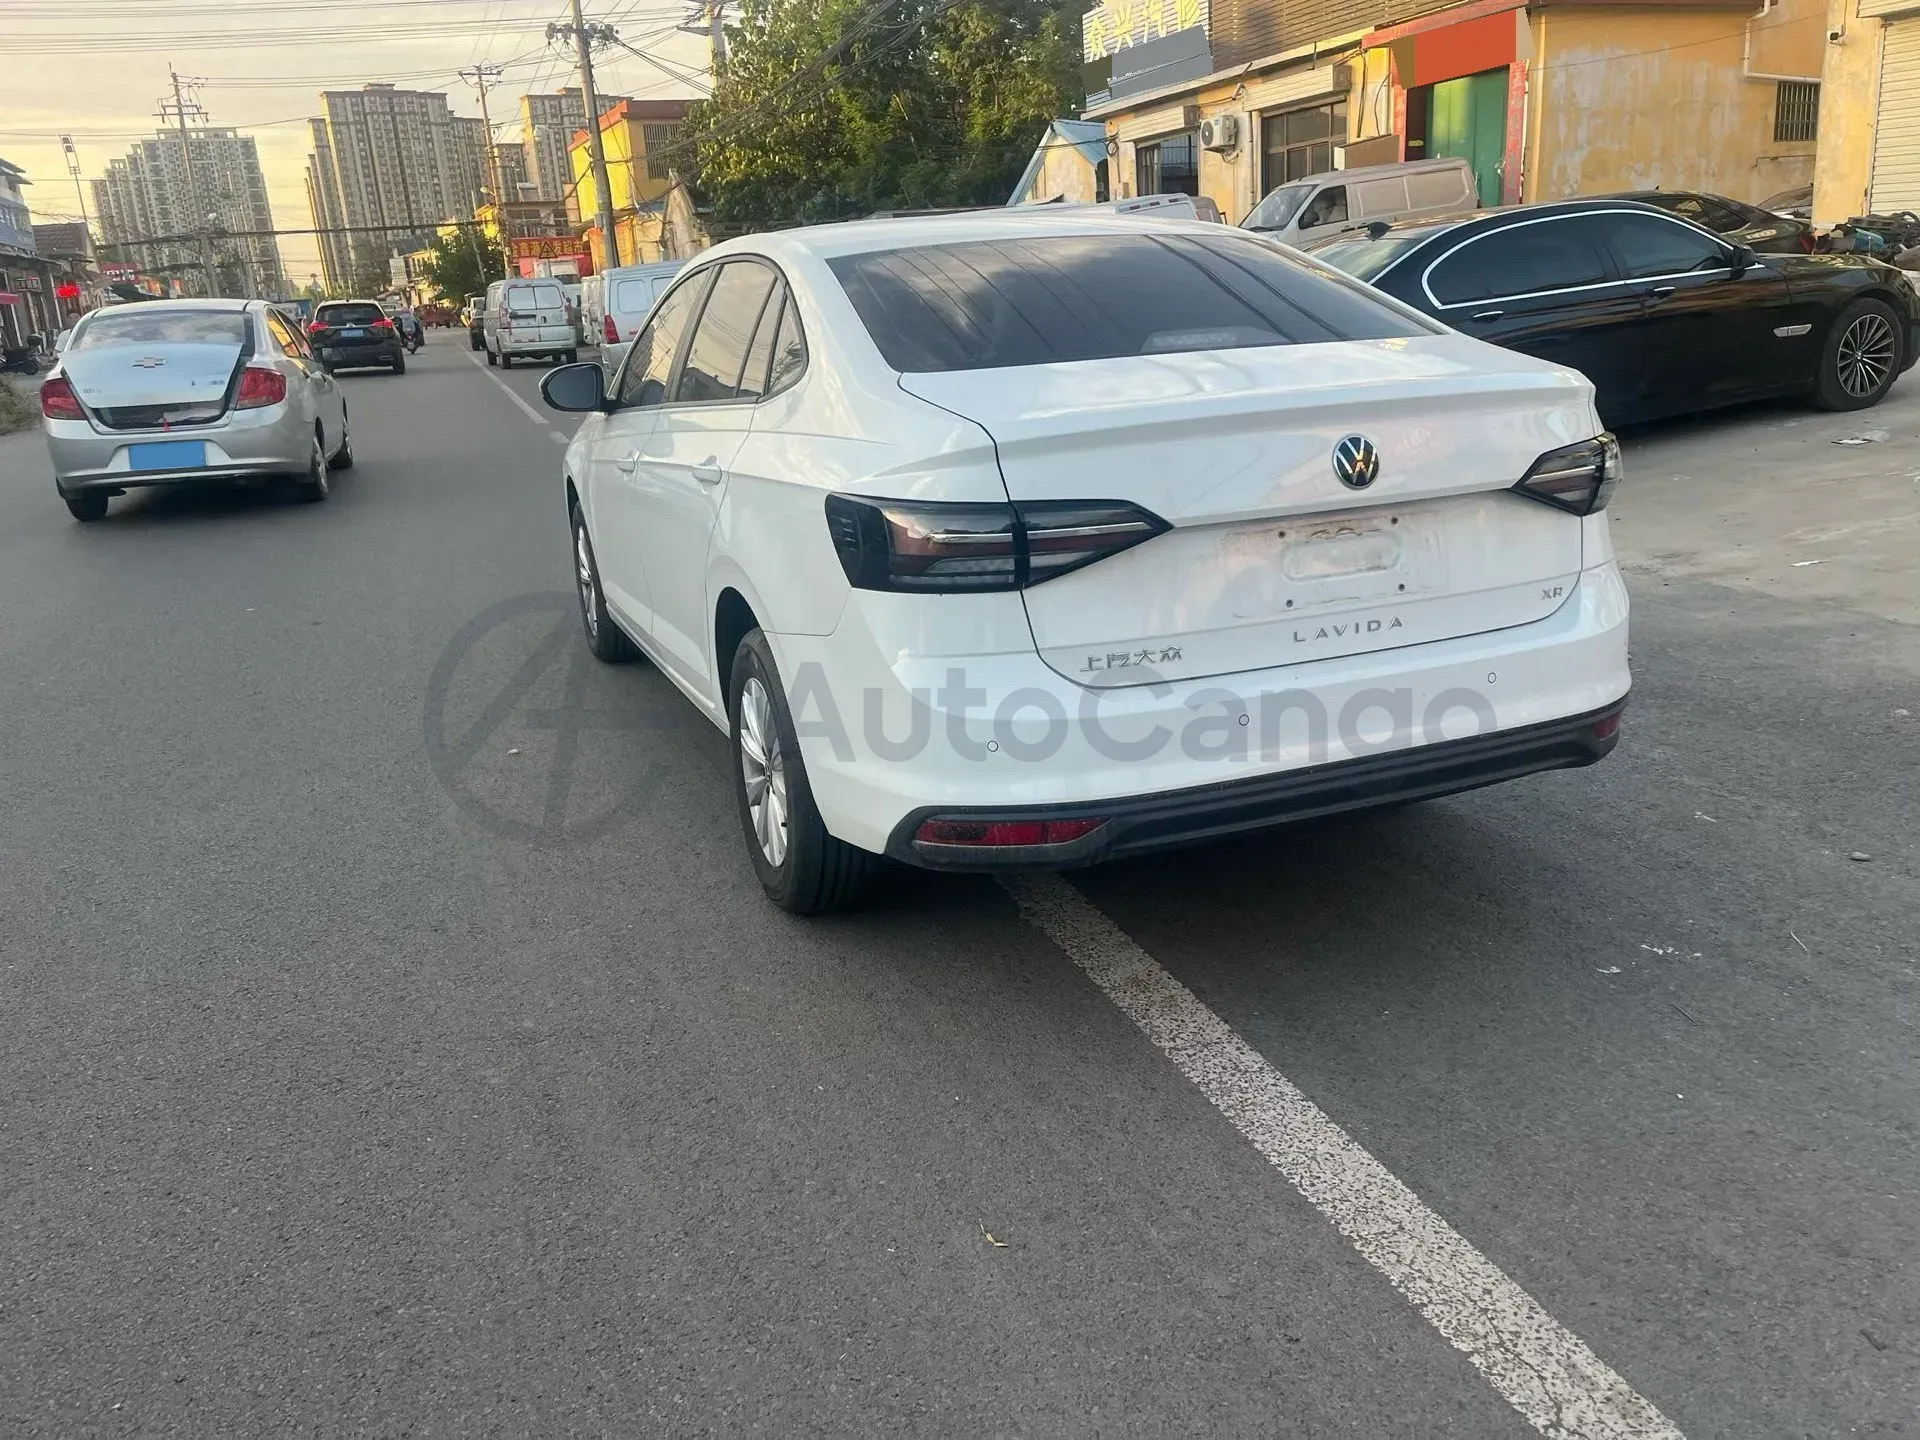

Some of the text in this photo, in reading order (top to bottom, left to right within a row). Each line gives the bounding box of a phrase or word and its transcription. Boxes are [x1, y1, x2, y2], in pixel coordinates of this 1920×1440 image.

[1293, 616, 1403, 643] LAVIDA
[1079, 645, 1183, 672] 上汽大众
